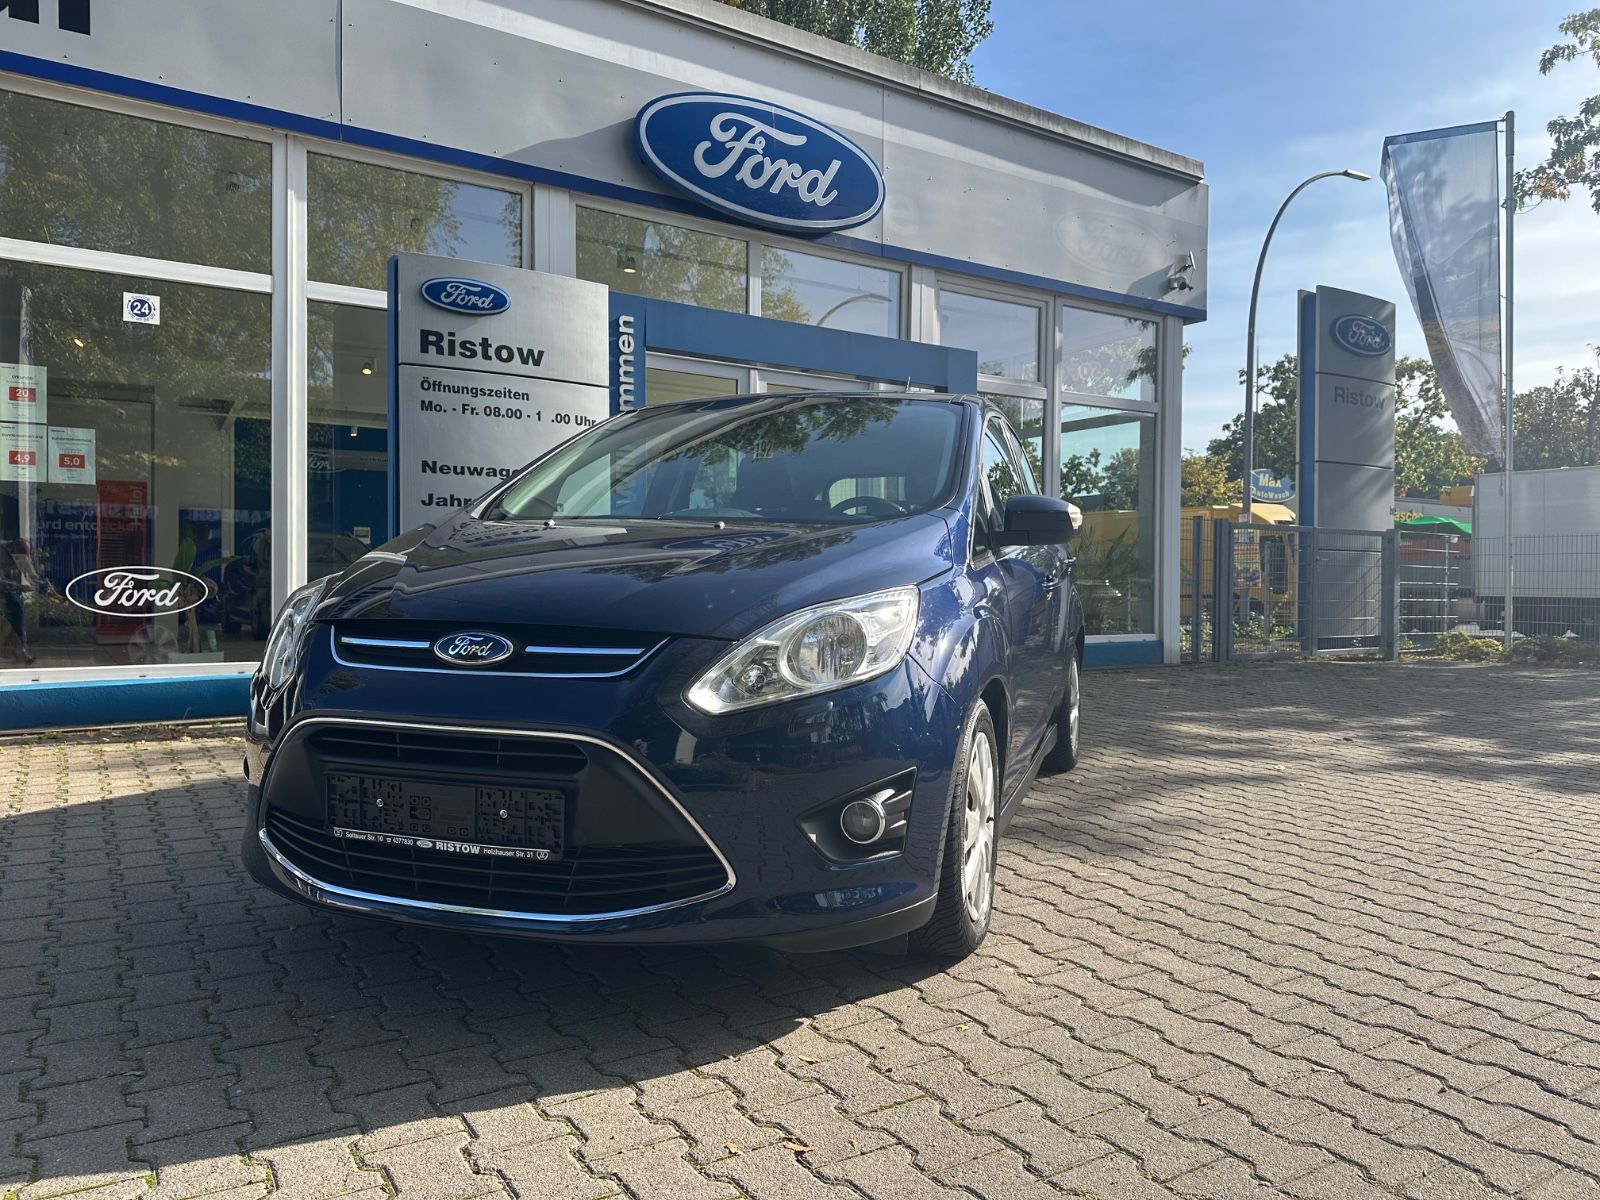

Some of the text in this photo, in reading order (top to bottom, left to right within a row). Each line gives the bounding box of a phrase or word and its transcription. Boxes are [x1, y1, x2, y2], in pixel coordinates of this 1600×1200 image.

[693, 112, 842, 206] Ford
[440, 282, 495, 309] Ford
[133, 301, 150, 315] 24
[1348, 320, 1386, 349] Ford
[420, 329, 545, 367] Ristow
[16, 388, 29, 398] 20
[420, 377, 530, 401] Öffnungszeiten
[1334, 386, 1386, 409] Ristow
[420, 400, 447, 413] Mo.
[461, 403, 479, 416] Fr.
[484, 405, 523, 420] 08.00
[575, 415, 596, 426] Uhr
[37, 519, 61, 531] ord
[94, 571, 181, 607] Ford
[448, 635, 494, 656] Ford
[435, 841, 480, 854] RISTOW
[483, 848, 515, 857] Holzhauser
[516, 850, 525, 858] Str.
